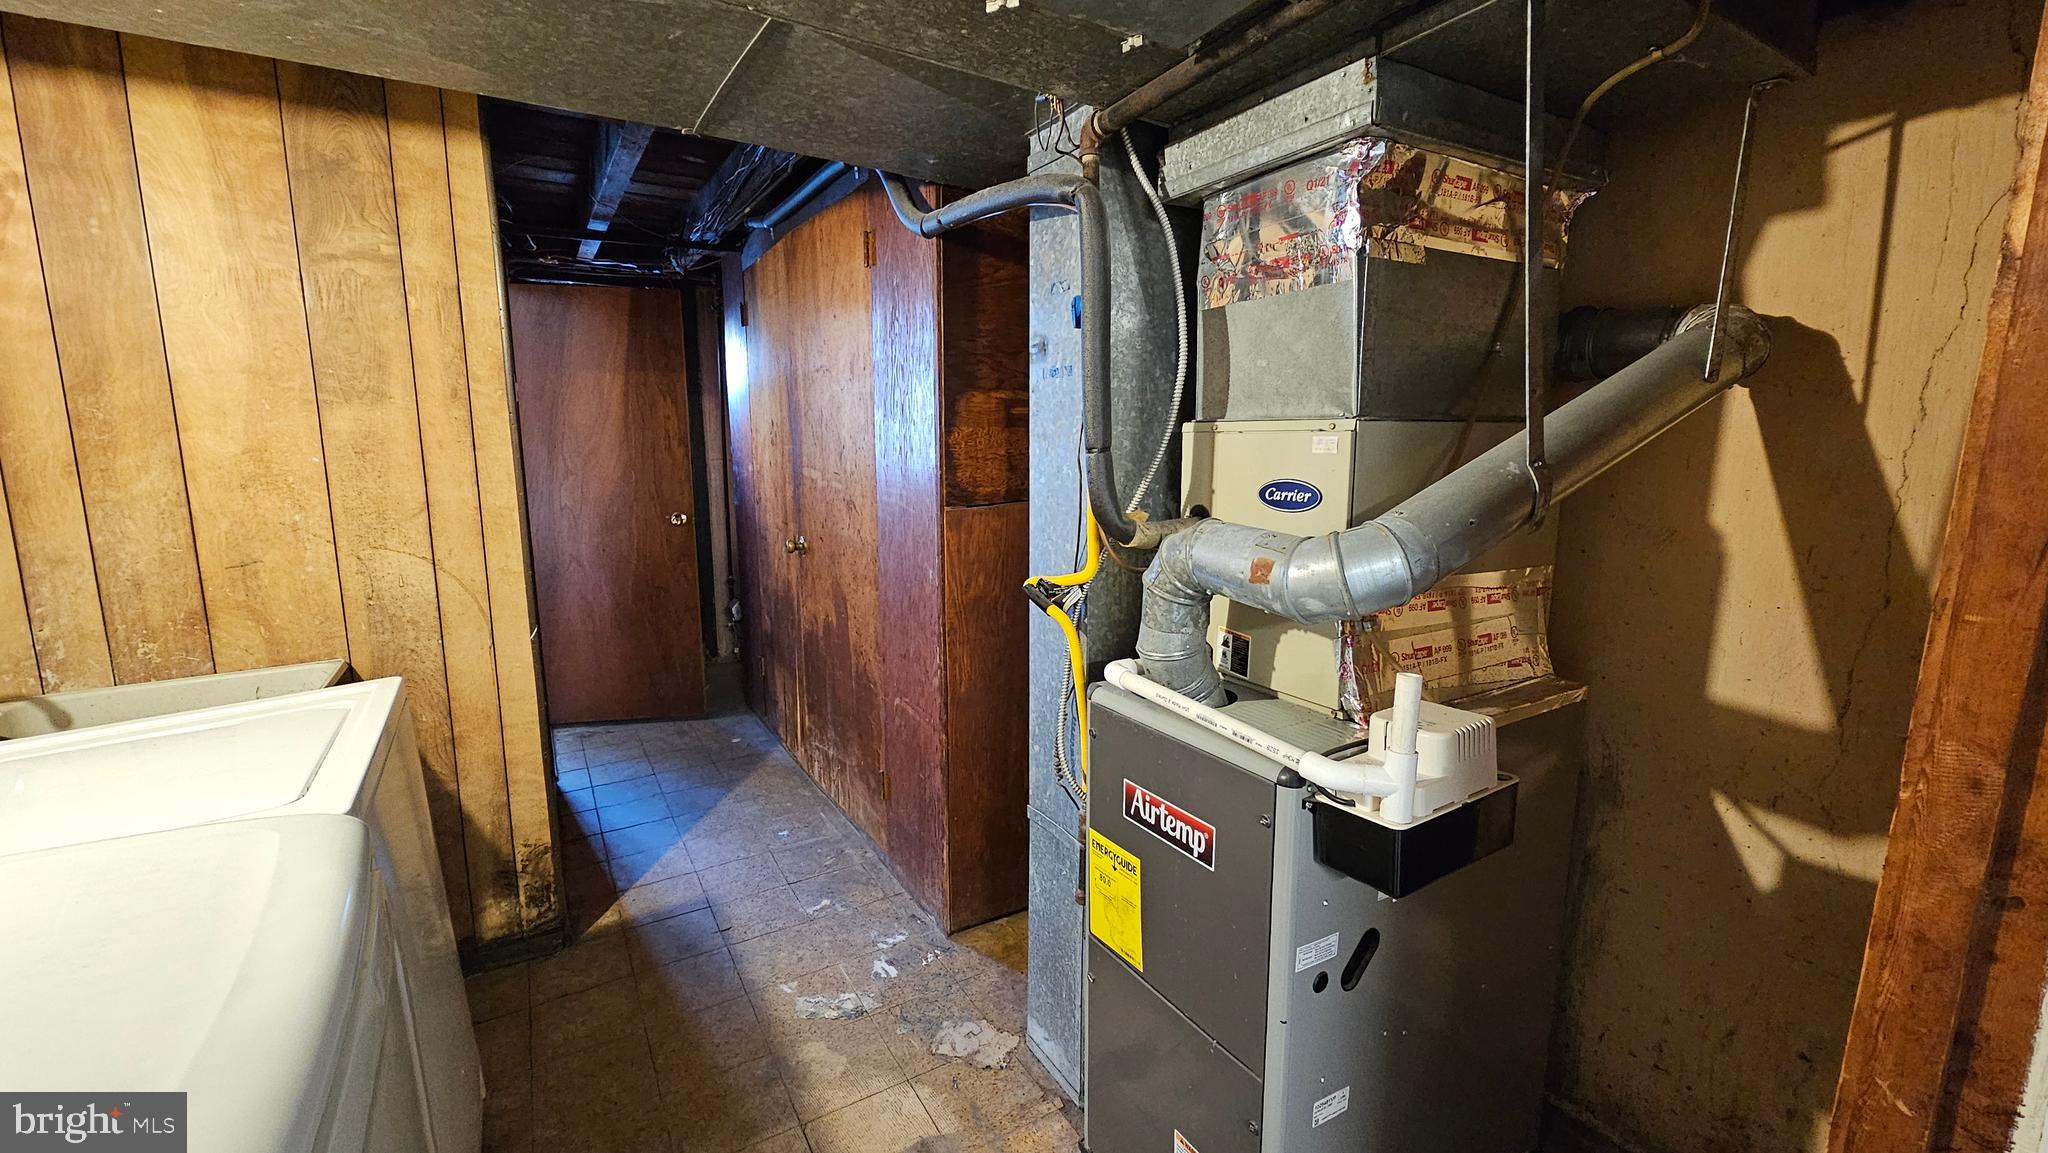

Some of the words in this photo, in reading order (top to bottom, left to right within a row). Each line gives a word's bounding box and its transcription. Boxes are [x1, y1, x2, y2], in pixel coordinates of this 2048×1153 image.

[1306, 175, 1330, 191] Q1/21
[1265, 487, 1312, 502] Carrier
[1131, 788, 1206, 857] Airtemp
